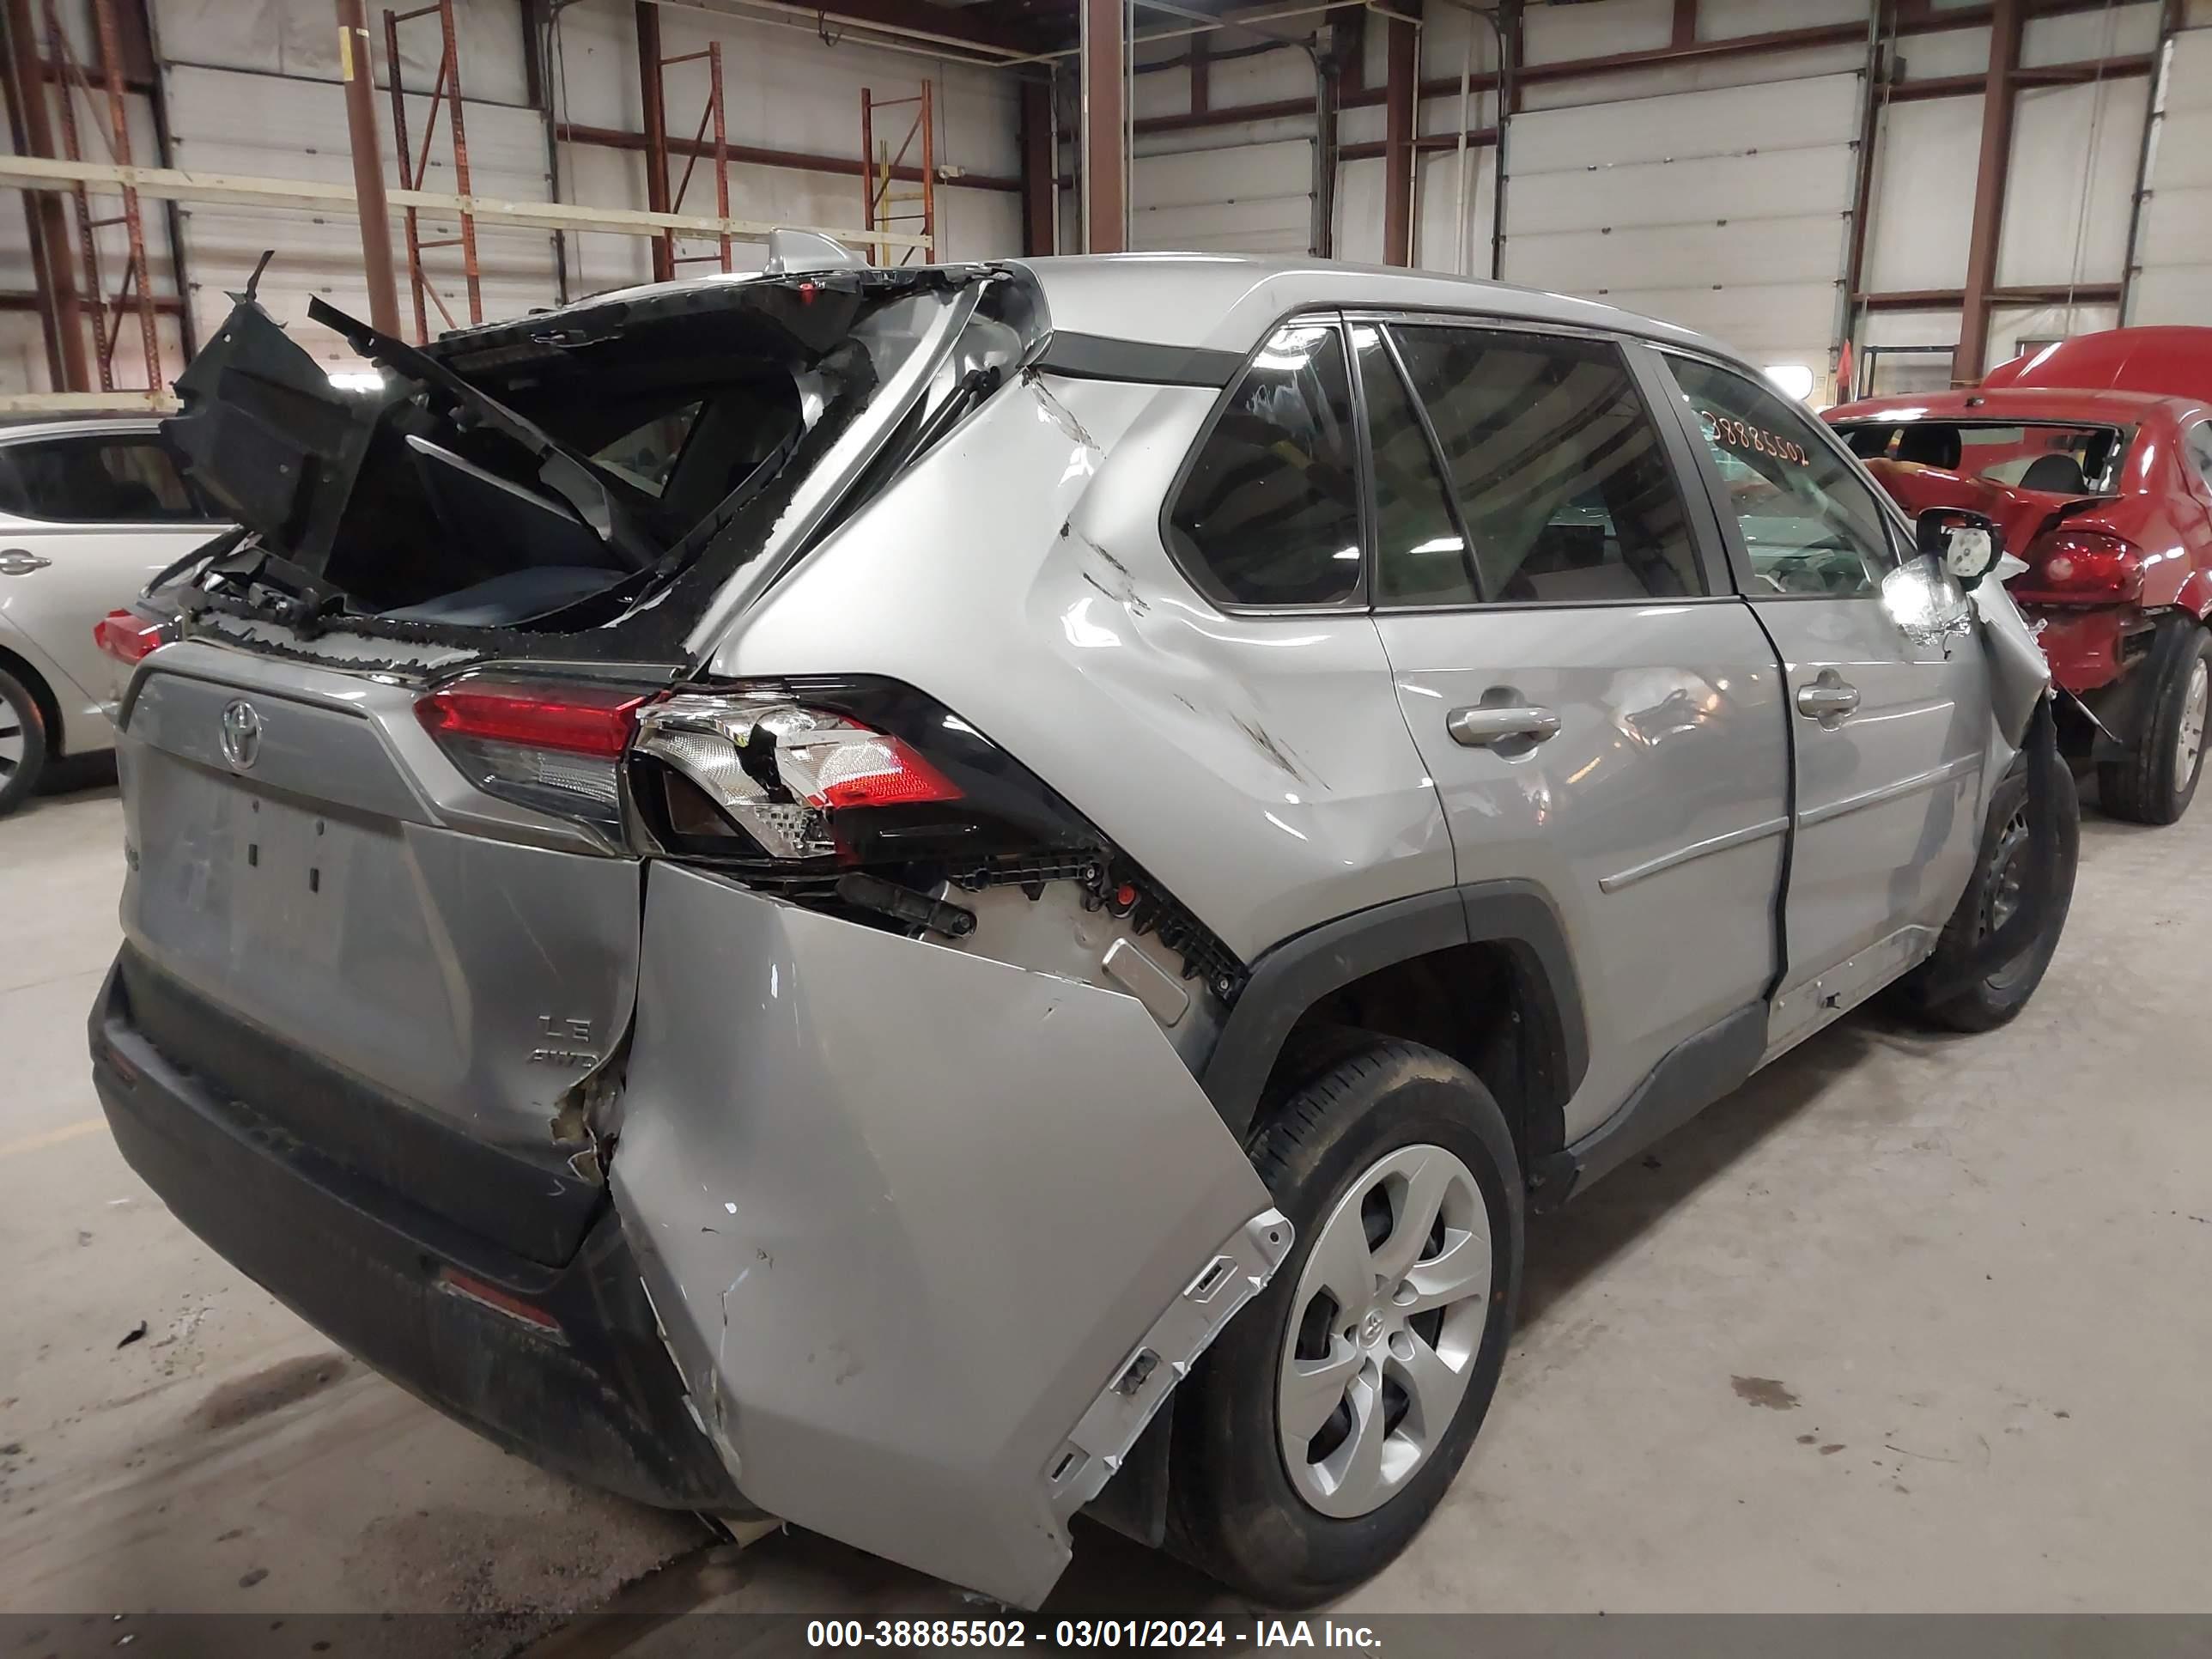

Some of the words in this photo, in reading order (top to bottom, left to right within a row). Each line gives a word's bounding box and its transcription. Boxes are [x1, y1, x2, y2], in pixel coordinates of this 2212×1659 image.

[1700, 410, 1810, 468] 38885502
[538, 1014, 592, 1042] LE
[526, 1048, 599, 1068] AWD
